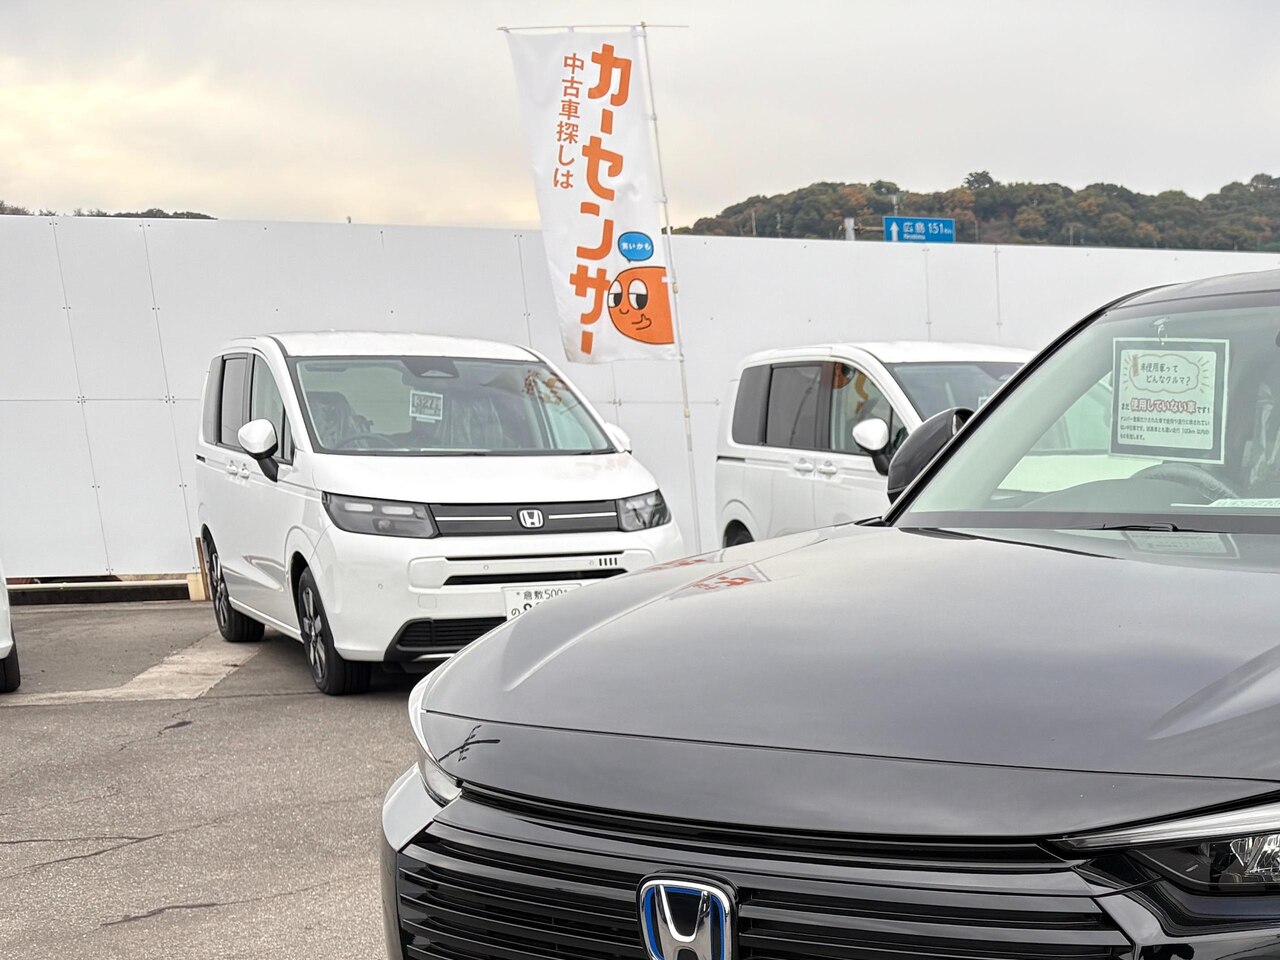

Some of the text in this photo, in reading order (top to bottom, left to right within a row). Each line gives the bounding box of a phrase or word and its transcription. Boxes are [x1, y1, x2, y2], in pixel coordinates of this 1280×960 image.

[553, 53, 585, 190] 中古車探しは
[569, 43, 632, 356] カーセンサー
